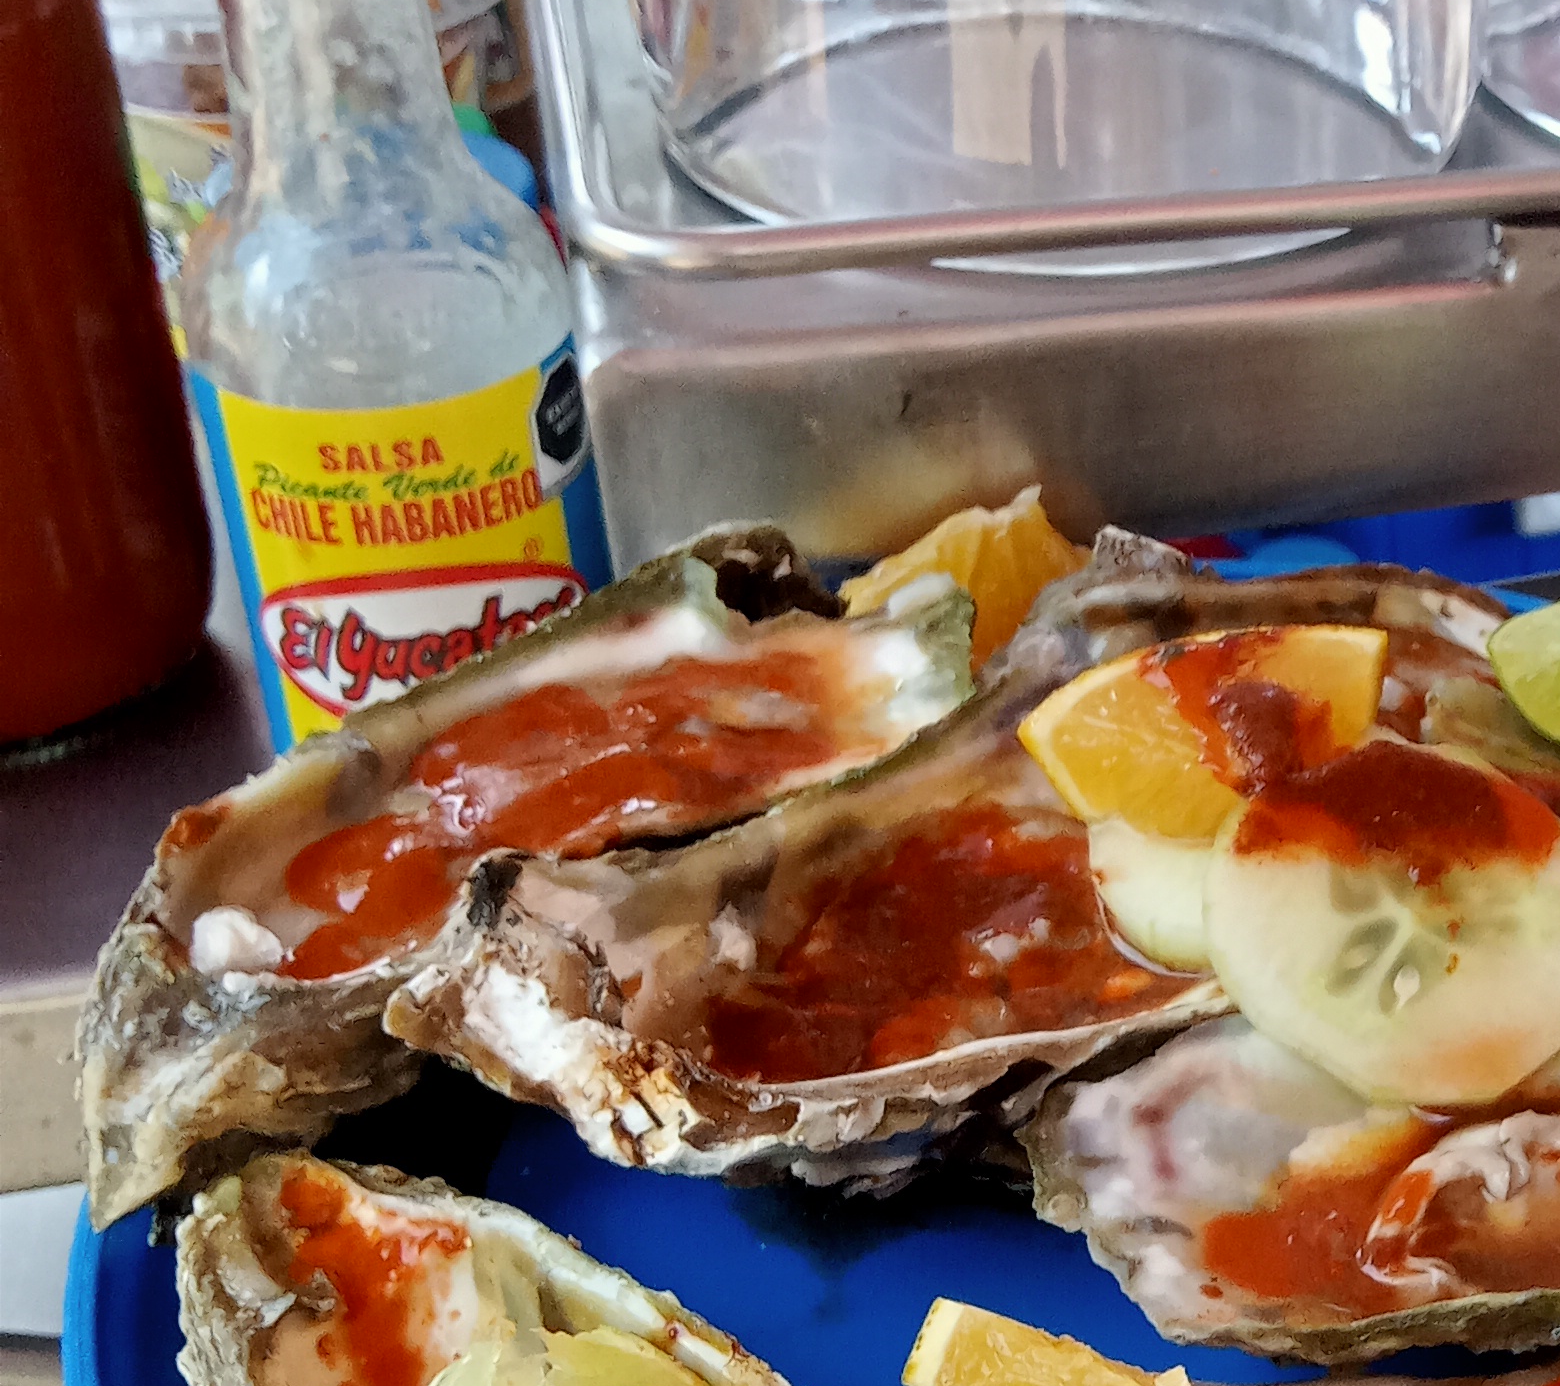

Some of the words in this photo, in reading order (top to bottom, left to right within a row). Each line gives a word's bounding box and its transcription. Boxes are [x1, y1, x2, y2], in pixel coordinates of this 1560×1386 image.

[254, 461, 369, 501] Picante
[383, 465, 477, 501] Verde
[318, 436, 445, 473] SALSA
[251, 487, 343, 545] CHILE
[351, 468, 542, 546] HABANERO
[280, 608, 332, 681] El
